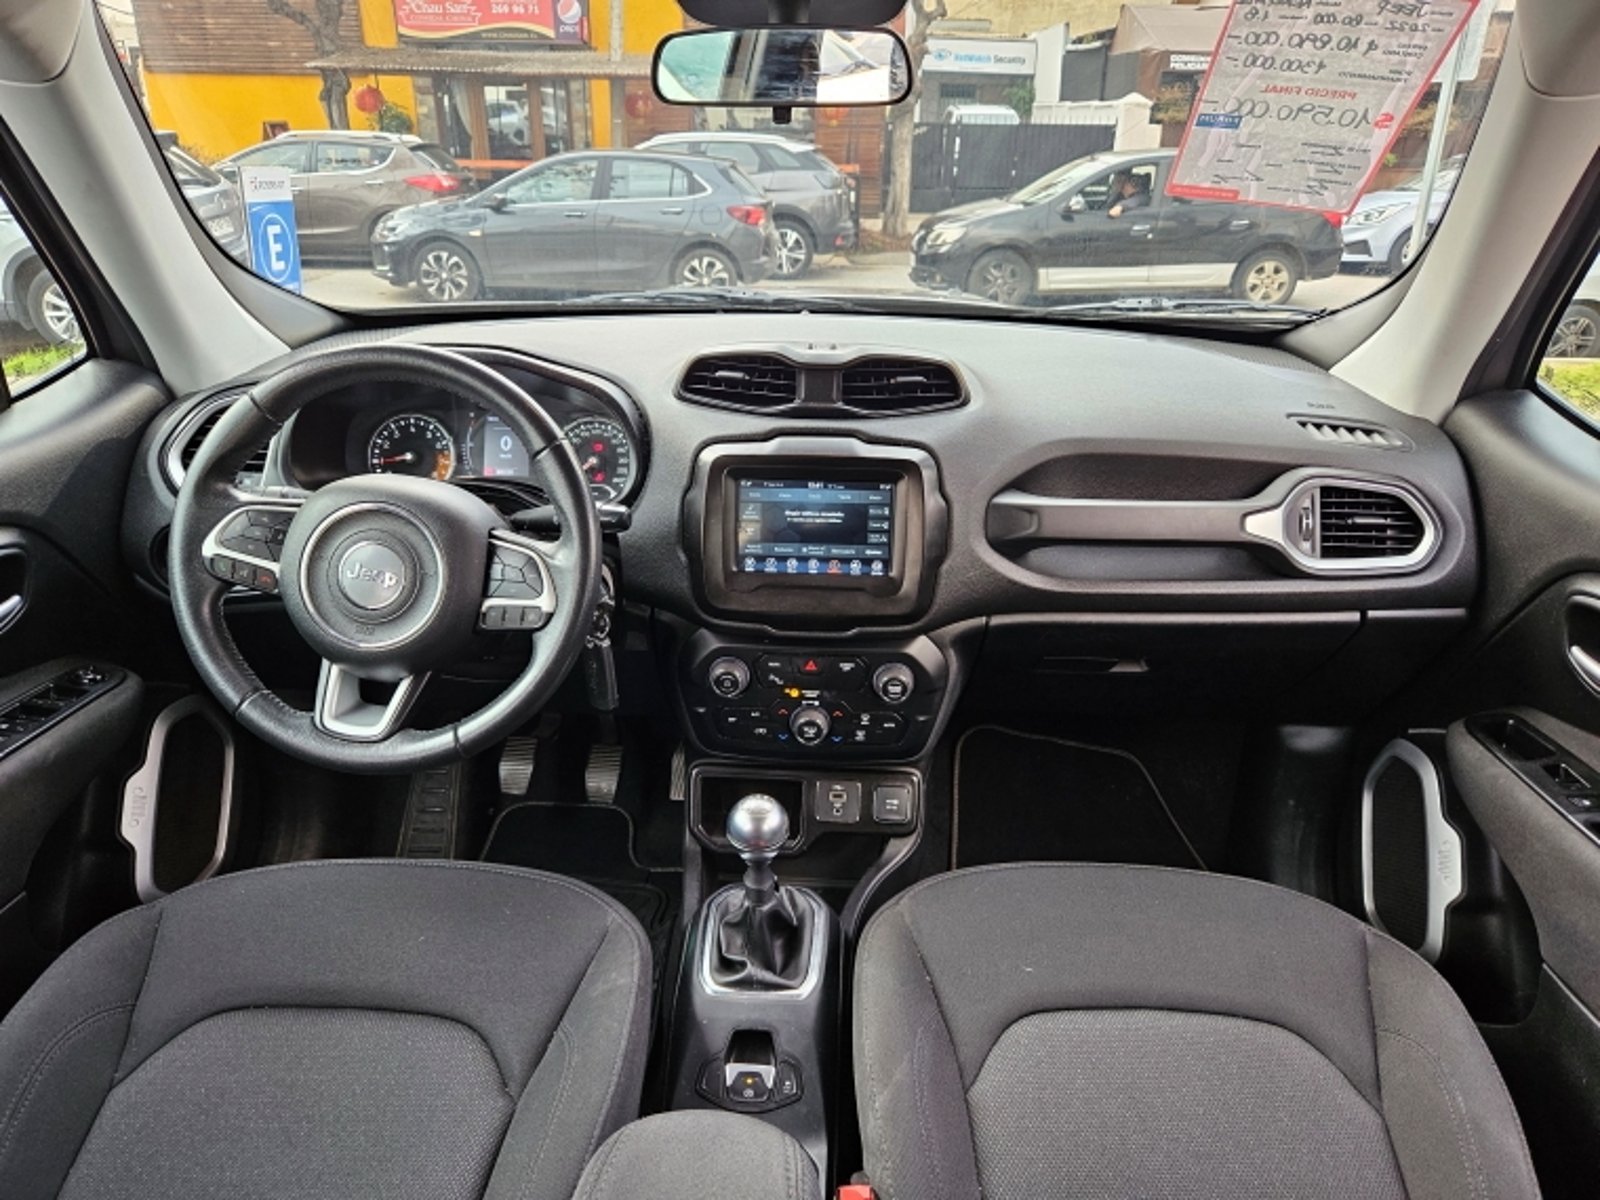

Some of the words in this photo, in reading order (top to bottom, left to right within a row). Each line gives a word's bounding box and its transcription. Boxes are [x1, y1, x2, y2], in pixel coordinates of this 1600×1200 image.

[993, 54, 1026, 65] Security
[267, 224, 286, 271] E
[500, 435, 513, 451] 0
[347, 562, 399, 588] Jeep
